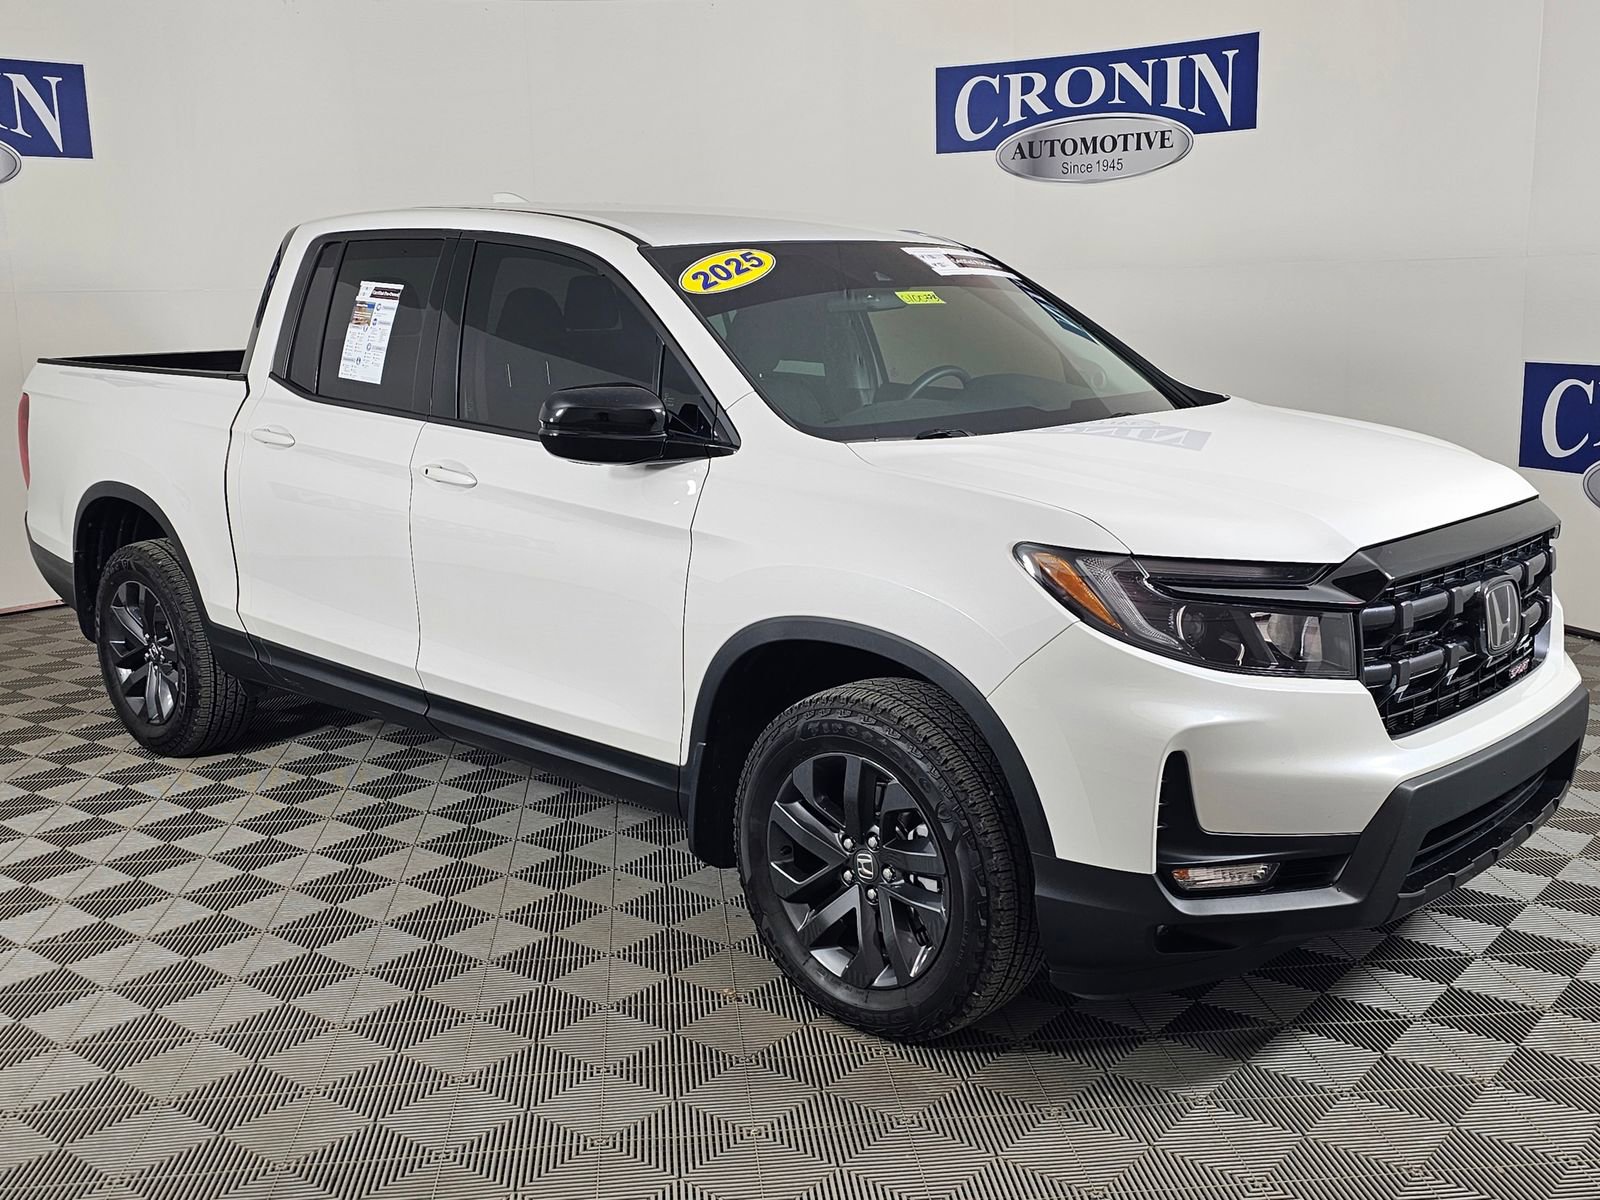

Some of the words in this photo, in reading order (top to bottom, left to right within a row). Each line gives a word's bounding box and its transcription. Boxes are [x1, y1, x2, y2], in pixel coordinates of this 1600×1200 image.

[0, 72, 64, 153] N
[954, 49, 1239, 142] CRONIN
[1011, 129, 1174, 161] AUTOMOTIVE
[1061, 161, 1093, 175] Since
[1096, 158, 1124, 173] 1945
[691, 251, 764, 290] 2025
[1541, 378, 1600, 459] C
